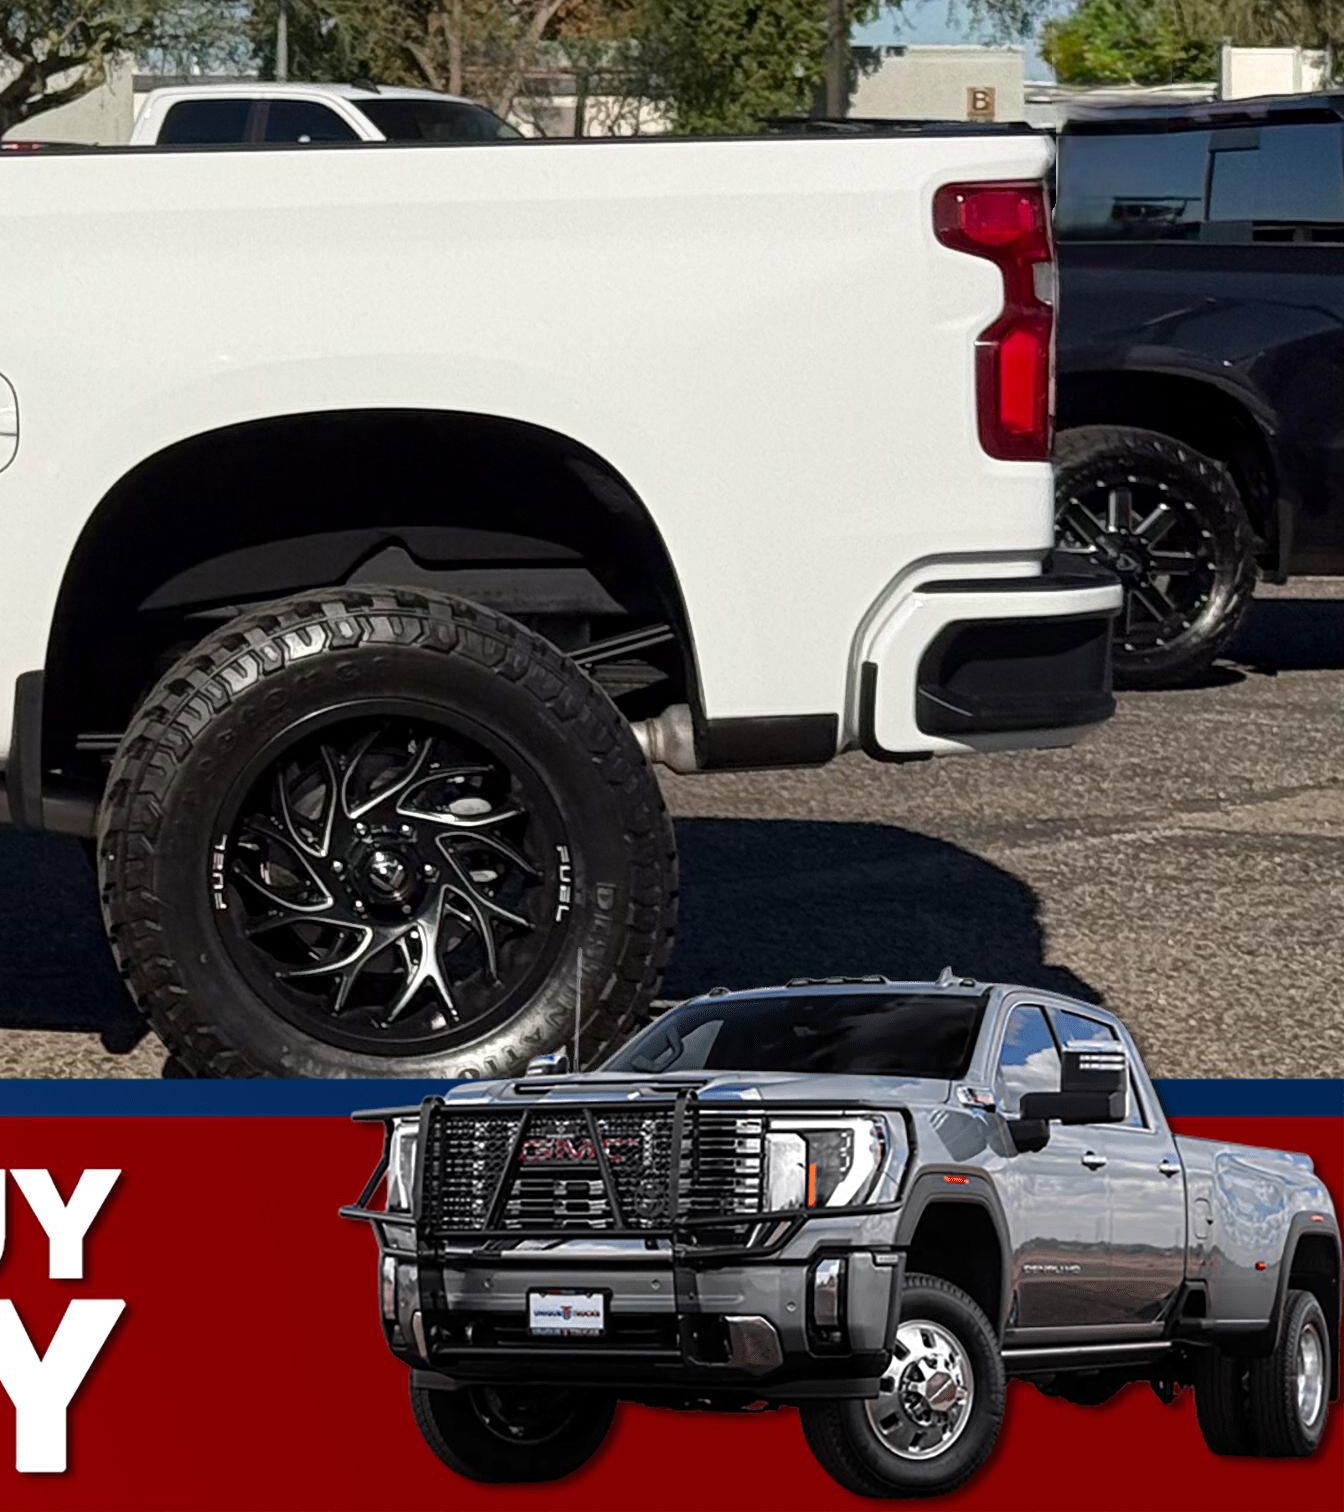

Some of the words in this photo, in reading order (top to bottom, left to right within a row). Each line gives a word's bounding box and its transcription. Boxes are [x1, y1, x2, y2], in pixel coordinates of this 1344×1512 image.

[972, 90, 990, 111] B
[212, 833, 228, 910] FUEL
[555, 845, 571, 922] FUEL
